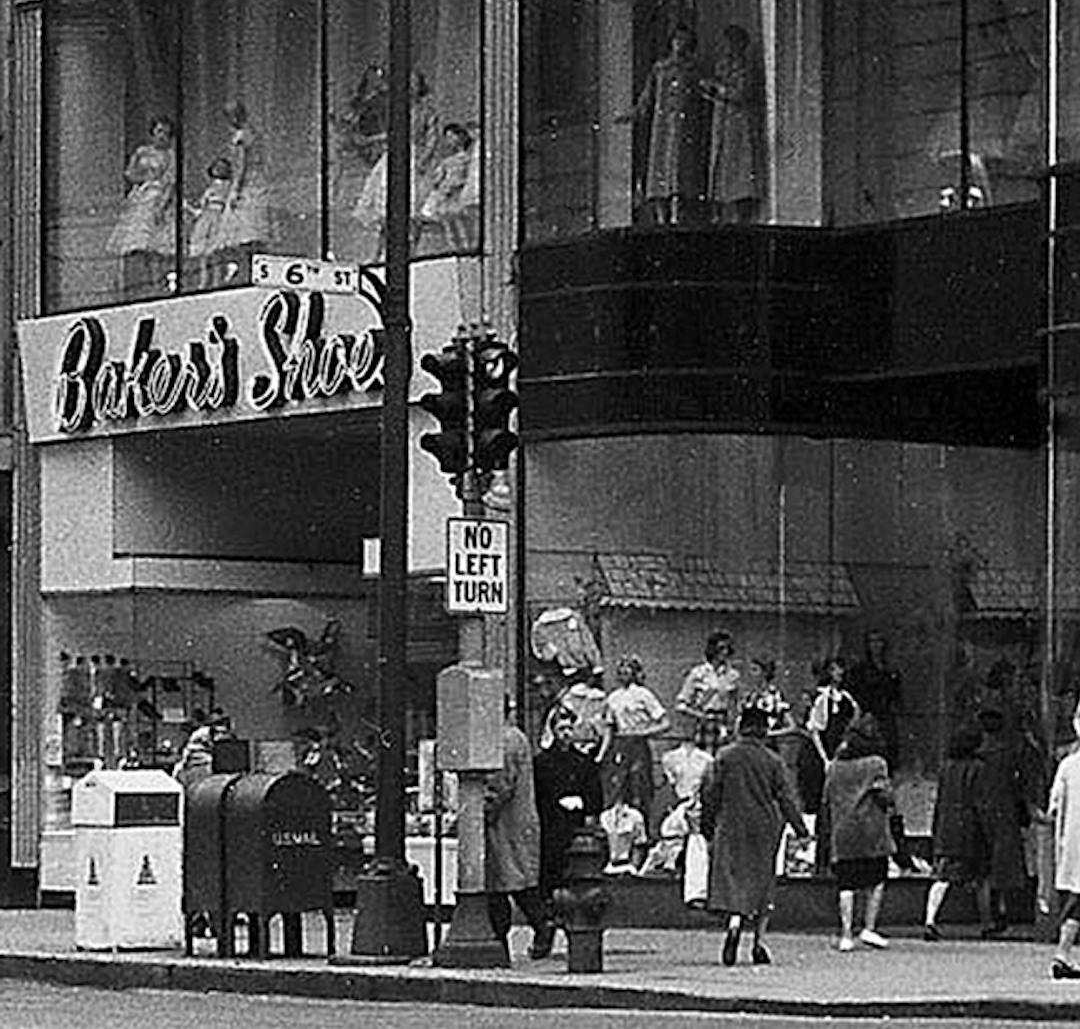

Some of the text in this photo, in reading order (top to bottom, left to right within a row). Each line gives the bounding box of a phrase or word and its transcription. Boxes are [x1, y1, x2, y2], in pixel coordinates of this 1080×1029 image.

[260, 264, 269, 279] S
[334, 270, 351, 286] ST
[56, 291, 385, 433] Baker's Shoe
[464, 525, 492, 549] NO
[455, 553, 502, 576] LEFT
[454, 580, 503, 604] TURN
